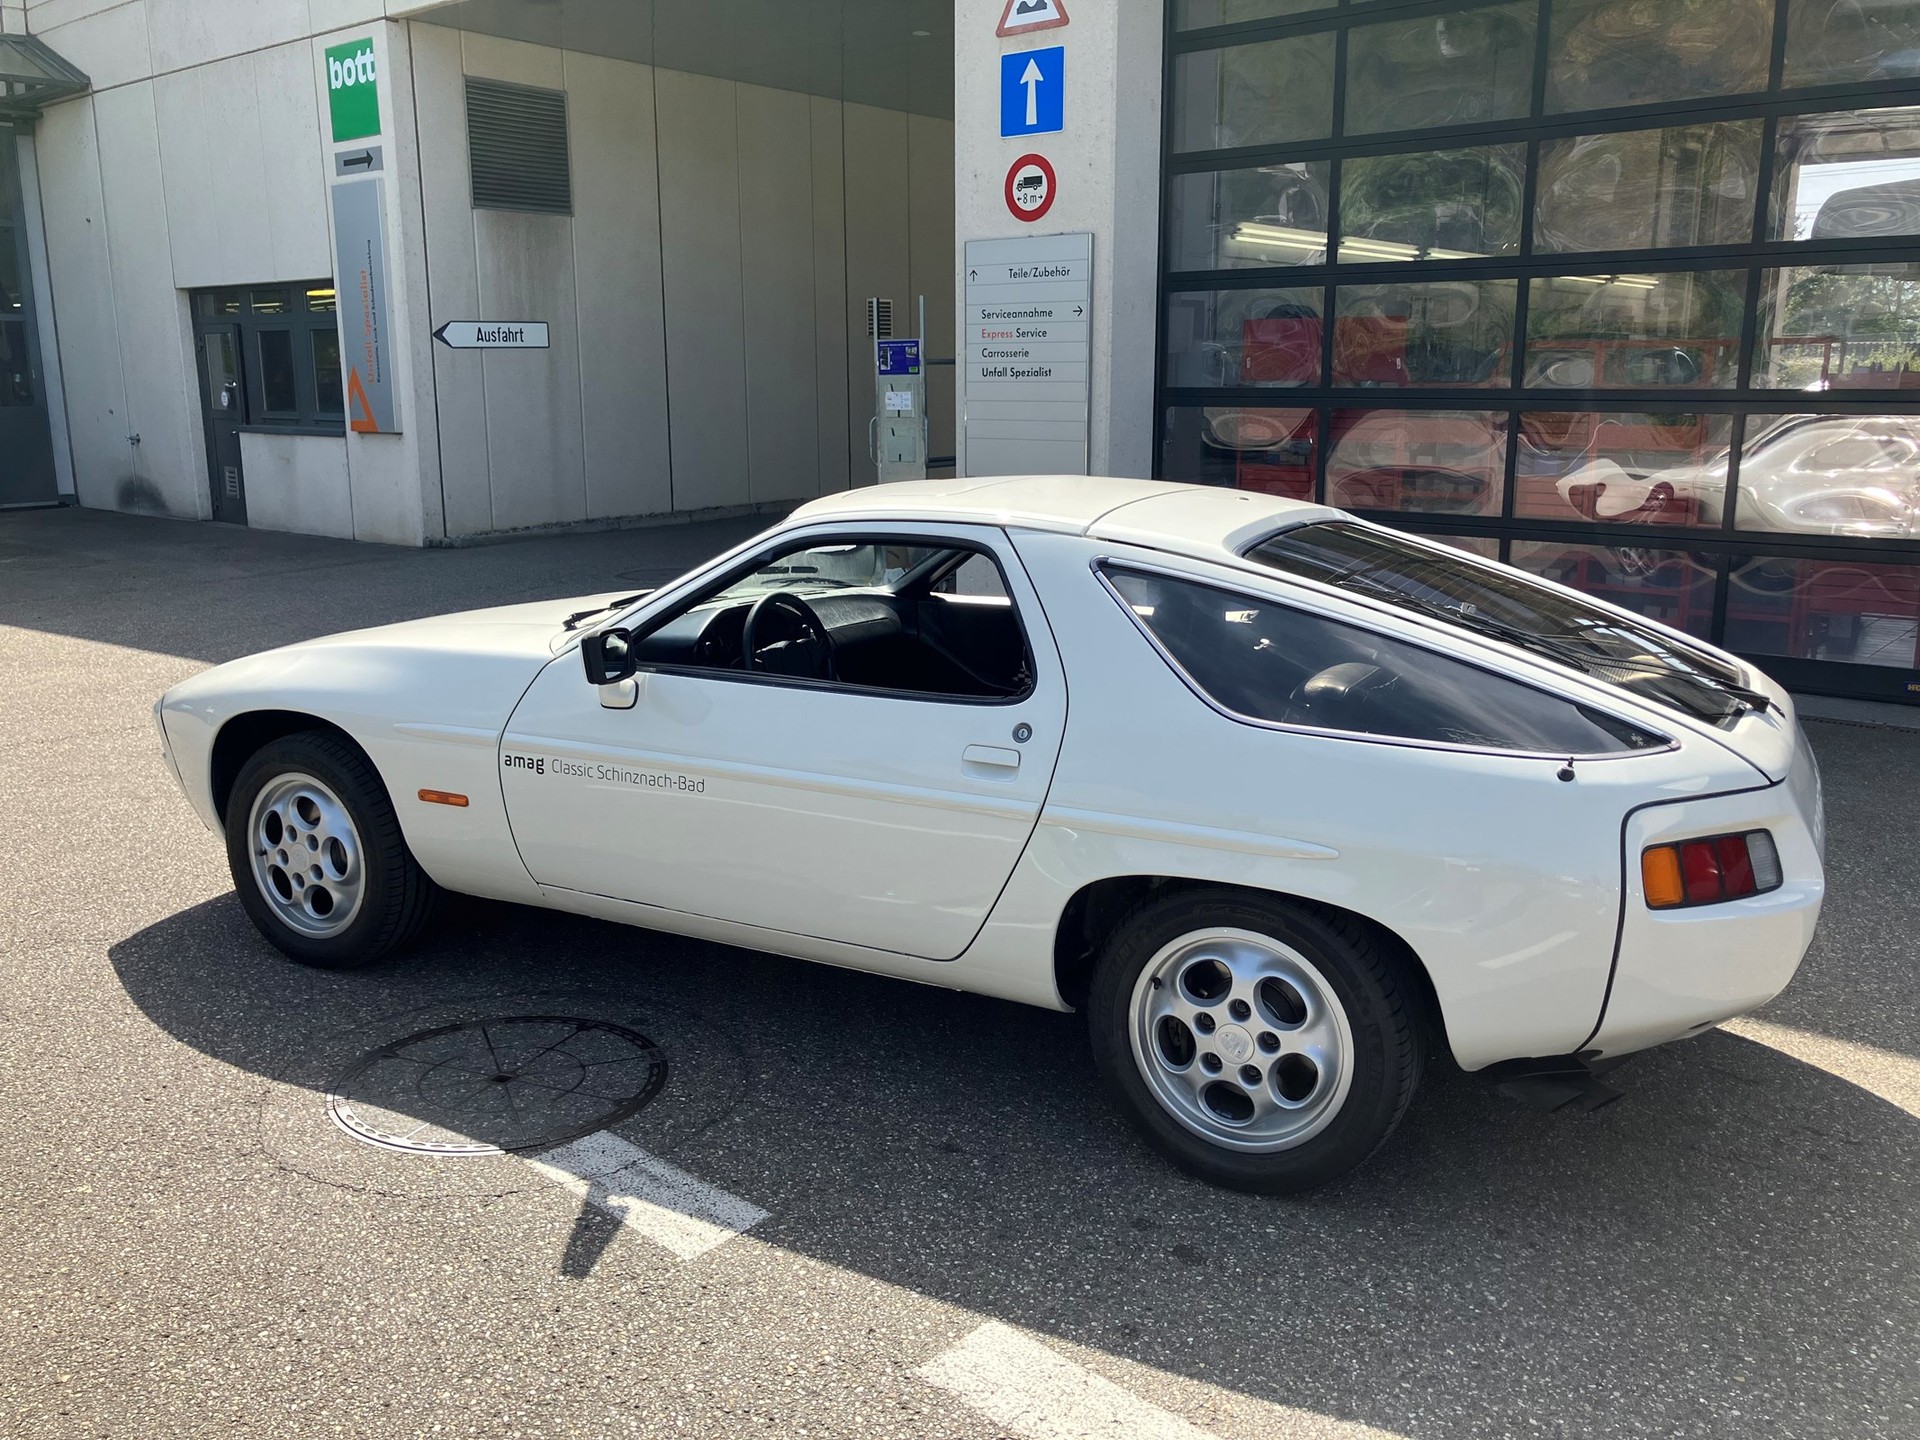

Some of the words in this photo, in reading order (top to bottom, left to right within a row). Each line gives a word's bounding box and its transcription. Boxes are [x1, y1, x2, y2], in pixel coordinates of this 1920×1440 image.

[328, 47, 376, 90] bott
[1023, 193, 1028, 204] 8
[1029, 194, 1037, 203] m
[1008, 266, 1071, 279] Teile/Zubehör
[981, 307, 1053, 320] Serviceannahme
[476, 326, 524, 343] Ausfahrt
[981, 328, 1013, 340] Express
[1016, 327, 1048, 338] Service
[981, 348, 1030, 358] Carrosserie
[364, 341, 375, 384] Unfall
[981, 367, 1008, 378] Unfall
[1010, 366, 1052, 380] Spezialist
[504, 754, 545, 775] amag
[551, 758, 594, 778] Classic
[597, 764, 705, 793] Schinznach-Bad
